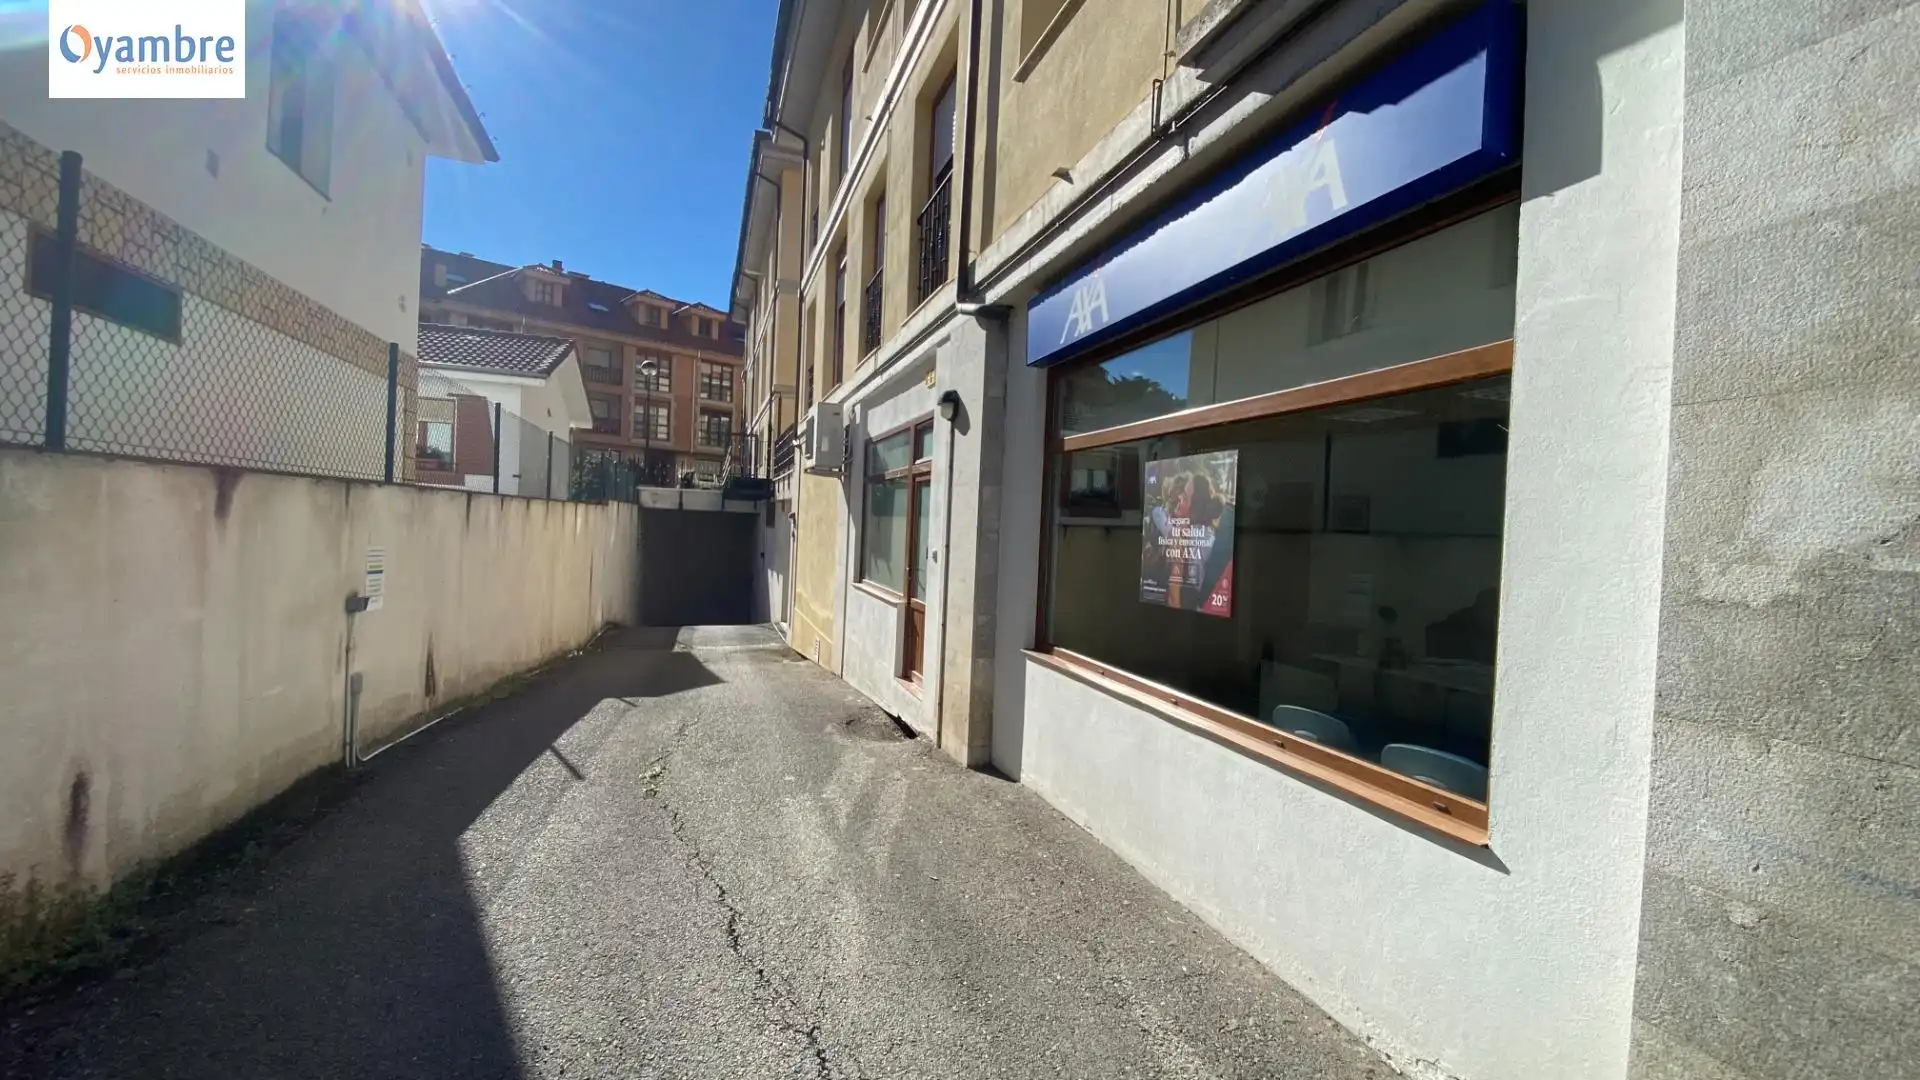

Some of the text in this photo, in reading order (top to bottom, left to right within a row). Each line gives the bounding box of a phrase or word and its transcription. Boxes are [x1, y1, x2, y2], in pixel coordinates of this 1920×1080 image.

[1060, 278, 1109, 344] AXA
[1172, 525, 1205, 537] tu salud
[1179, 537, 1214, 547] emocional
[1166, 547, 1202, 560] con AXA
